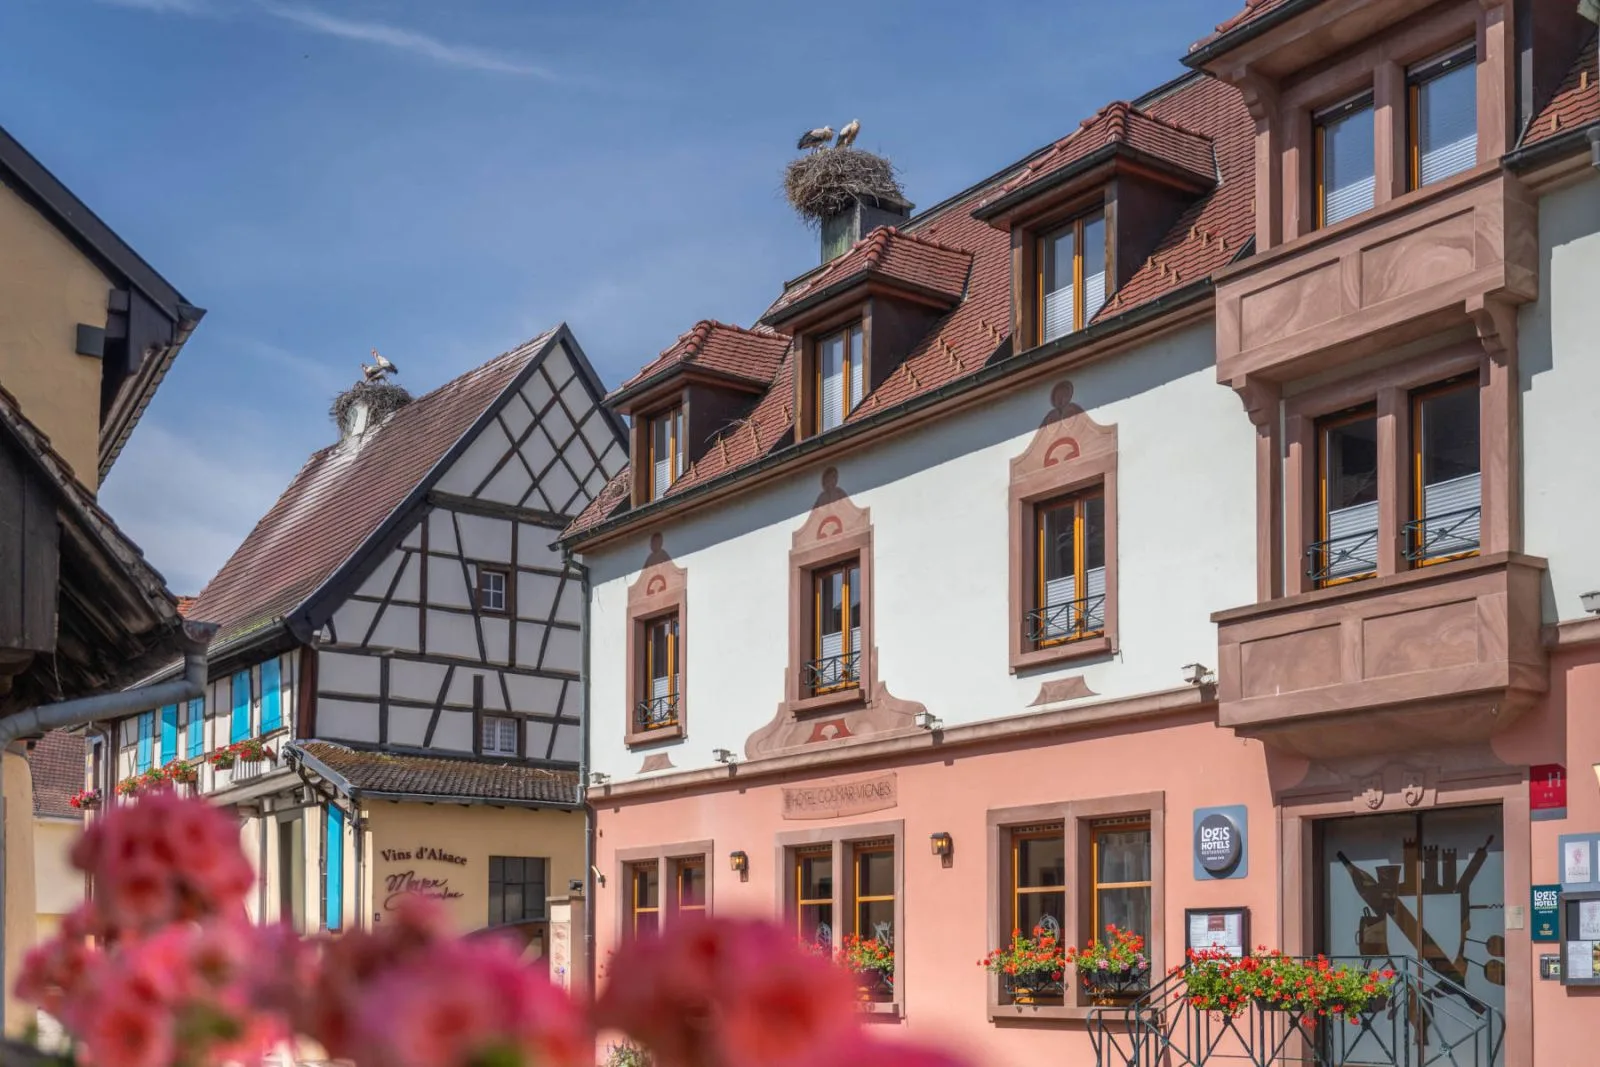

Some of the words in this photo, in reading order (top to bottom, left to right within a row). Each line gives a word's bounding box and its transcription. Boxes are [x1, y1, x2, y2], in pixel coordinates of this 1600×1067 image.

[1201, 840, 1230, 850] HOTELS
[381, 849, 411, 862] Vins
[415, 846, 468, 866] d'Alsace
